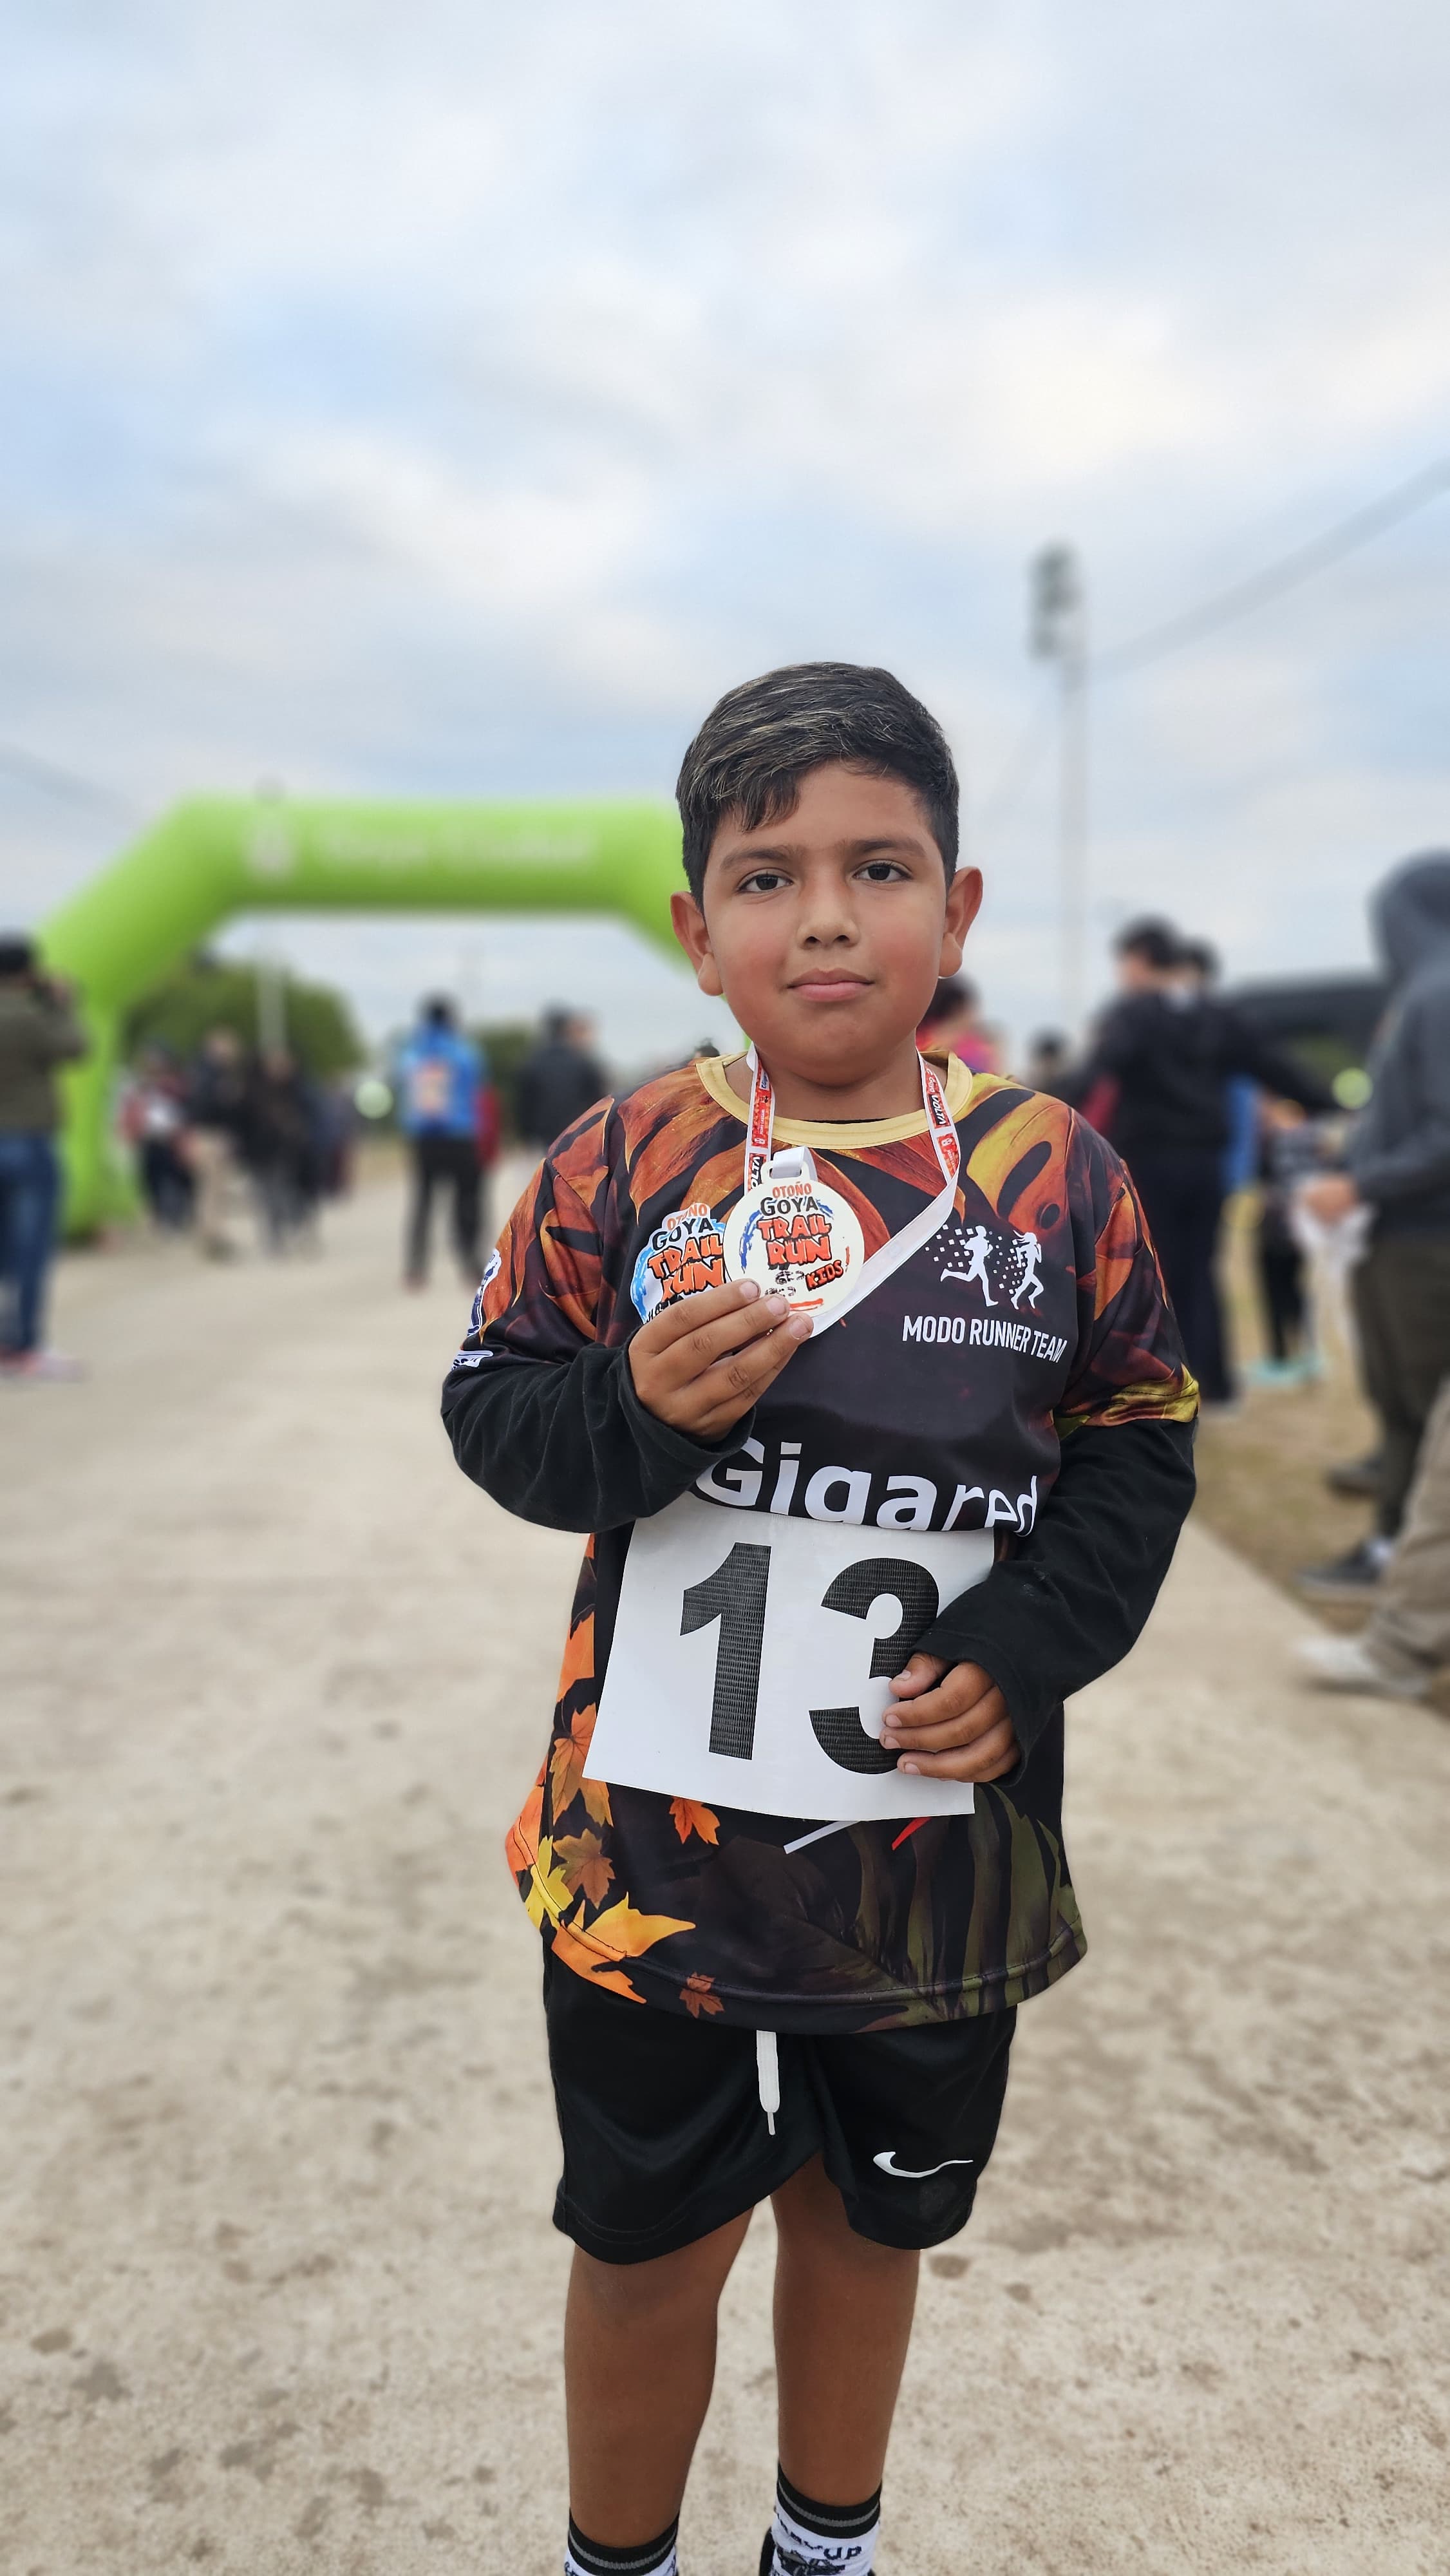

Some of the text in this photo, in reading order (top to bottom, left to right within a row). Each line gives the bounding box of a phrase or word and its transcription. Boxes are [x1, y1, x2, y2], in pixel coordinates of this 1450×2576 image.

[932, 1094, 946, 1125] VOLTA
[751, 1157, 760, 1189] OLTA
[772, 1181, 812, 1198] OTOÑO
[760, 1196, 819, 1216] GOYA
[652, 1218, 713, 1251] GOYA
[757, 1214, 832, 1240] TRAIL
[766, 1236, 832, 1266] RUN
[805, 1260, 844, 1291] KIDS
[902, 1315, 1068, 1363] MODO RUNNER TEAM
[680, 1542, 940, 1774] 13
